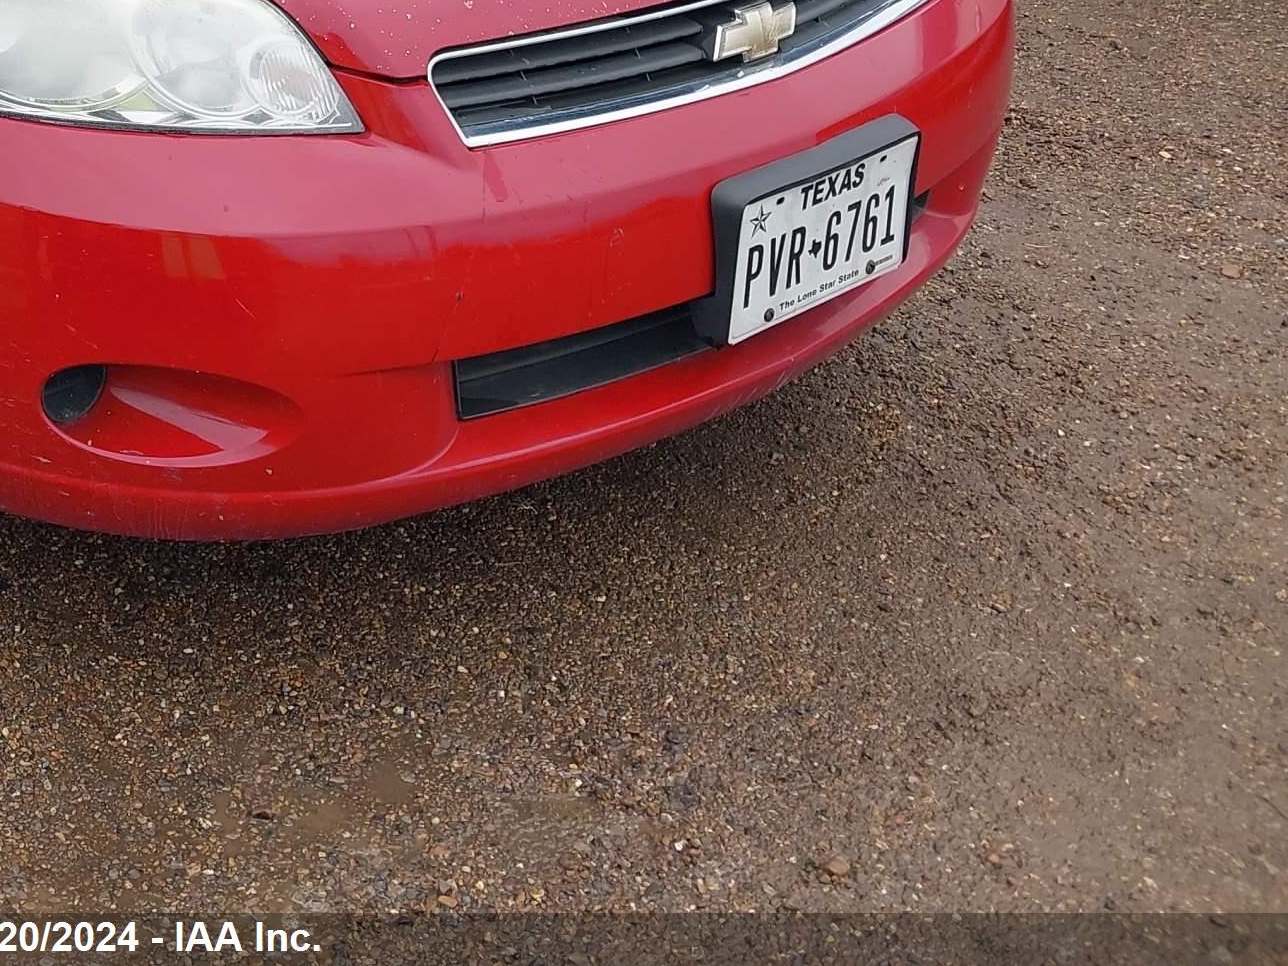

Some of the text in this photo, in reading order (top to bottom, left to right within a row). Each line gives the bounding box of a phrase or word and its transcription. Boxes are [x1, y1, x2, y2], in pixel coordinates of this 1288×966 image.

[800, 162, 866, 211] TEXAS
[743, 185, 896, 309] PVR 6761
[779, 269, 859, 311] The Lone Star State
